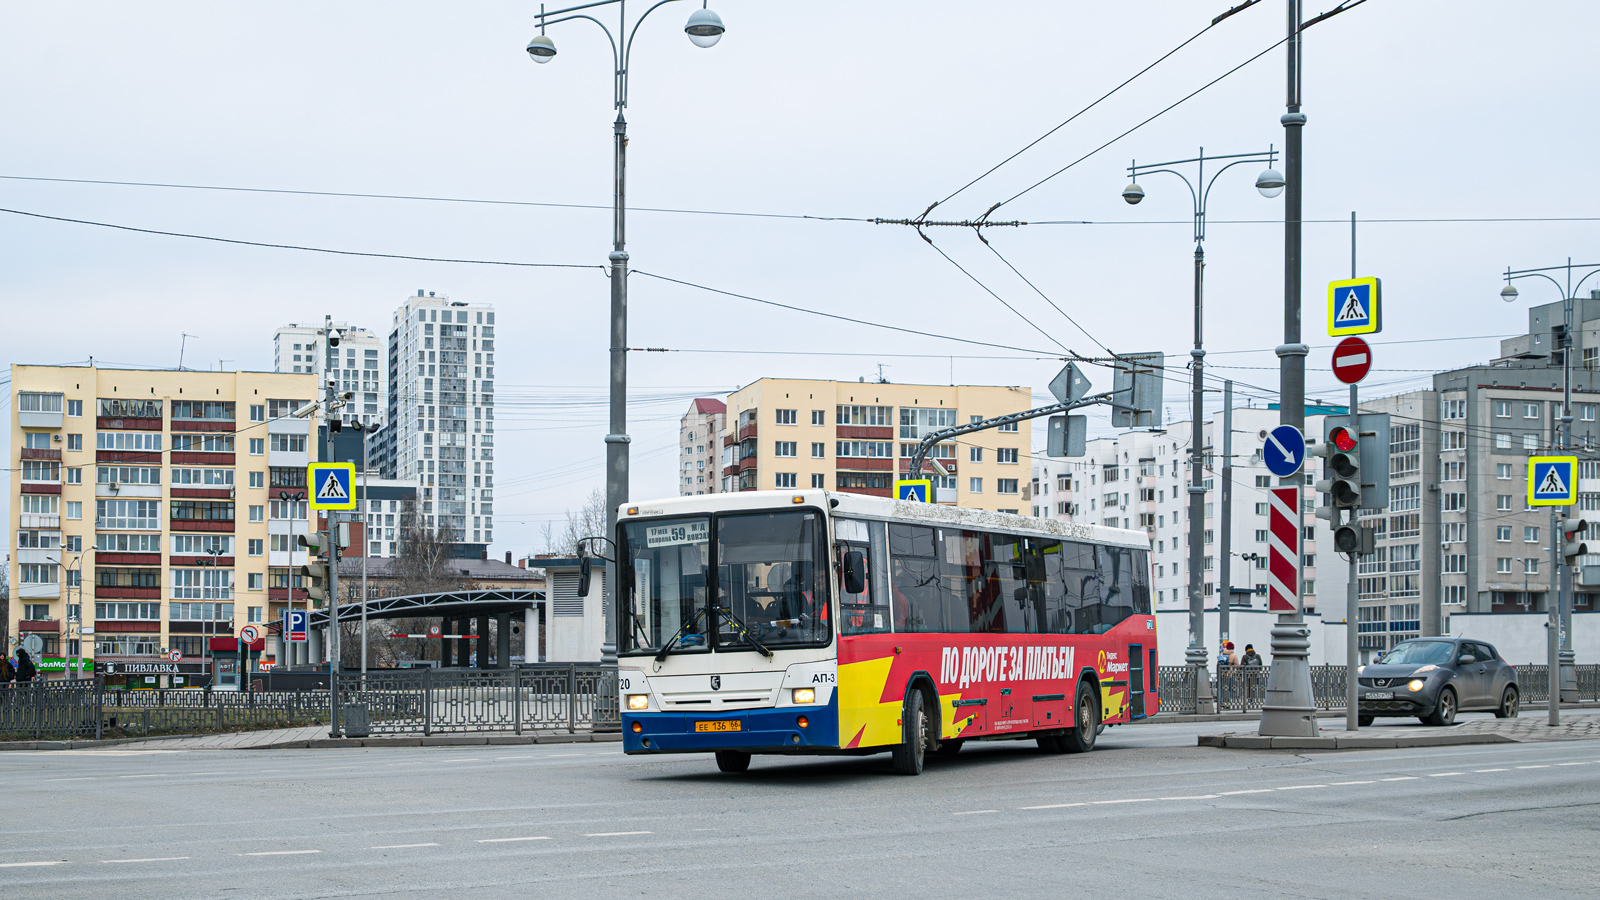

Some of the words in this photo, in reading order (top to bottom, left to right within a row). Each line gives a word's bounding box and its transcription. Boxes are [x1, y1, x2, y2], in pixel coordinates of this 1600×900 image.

[651, 528, 657, 536] 17
[691, 523, 705, 532] Ж/Д
[671, 527, 686, 541] 59
[125, 664, 180, 672] ПИВЛАВКА
[940, 647, 958, 684] ПО
[959, 646, 1008, 688] ДОРОГЕ
[1008, 647, 1024, 681] ЗА
[1025, 646, 1075, 680] ПЛАТЬЕМ
[1106, 661, 1128, 674] Маркет
[812, 672, 835, 683] АП-3
[712, 721, 726, 731] 136
[730, 720, 738, 728] 66
